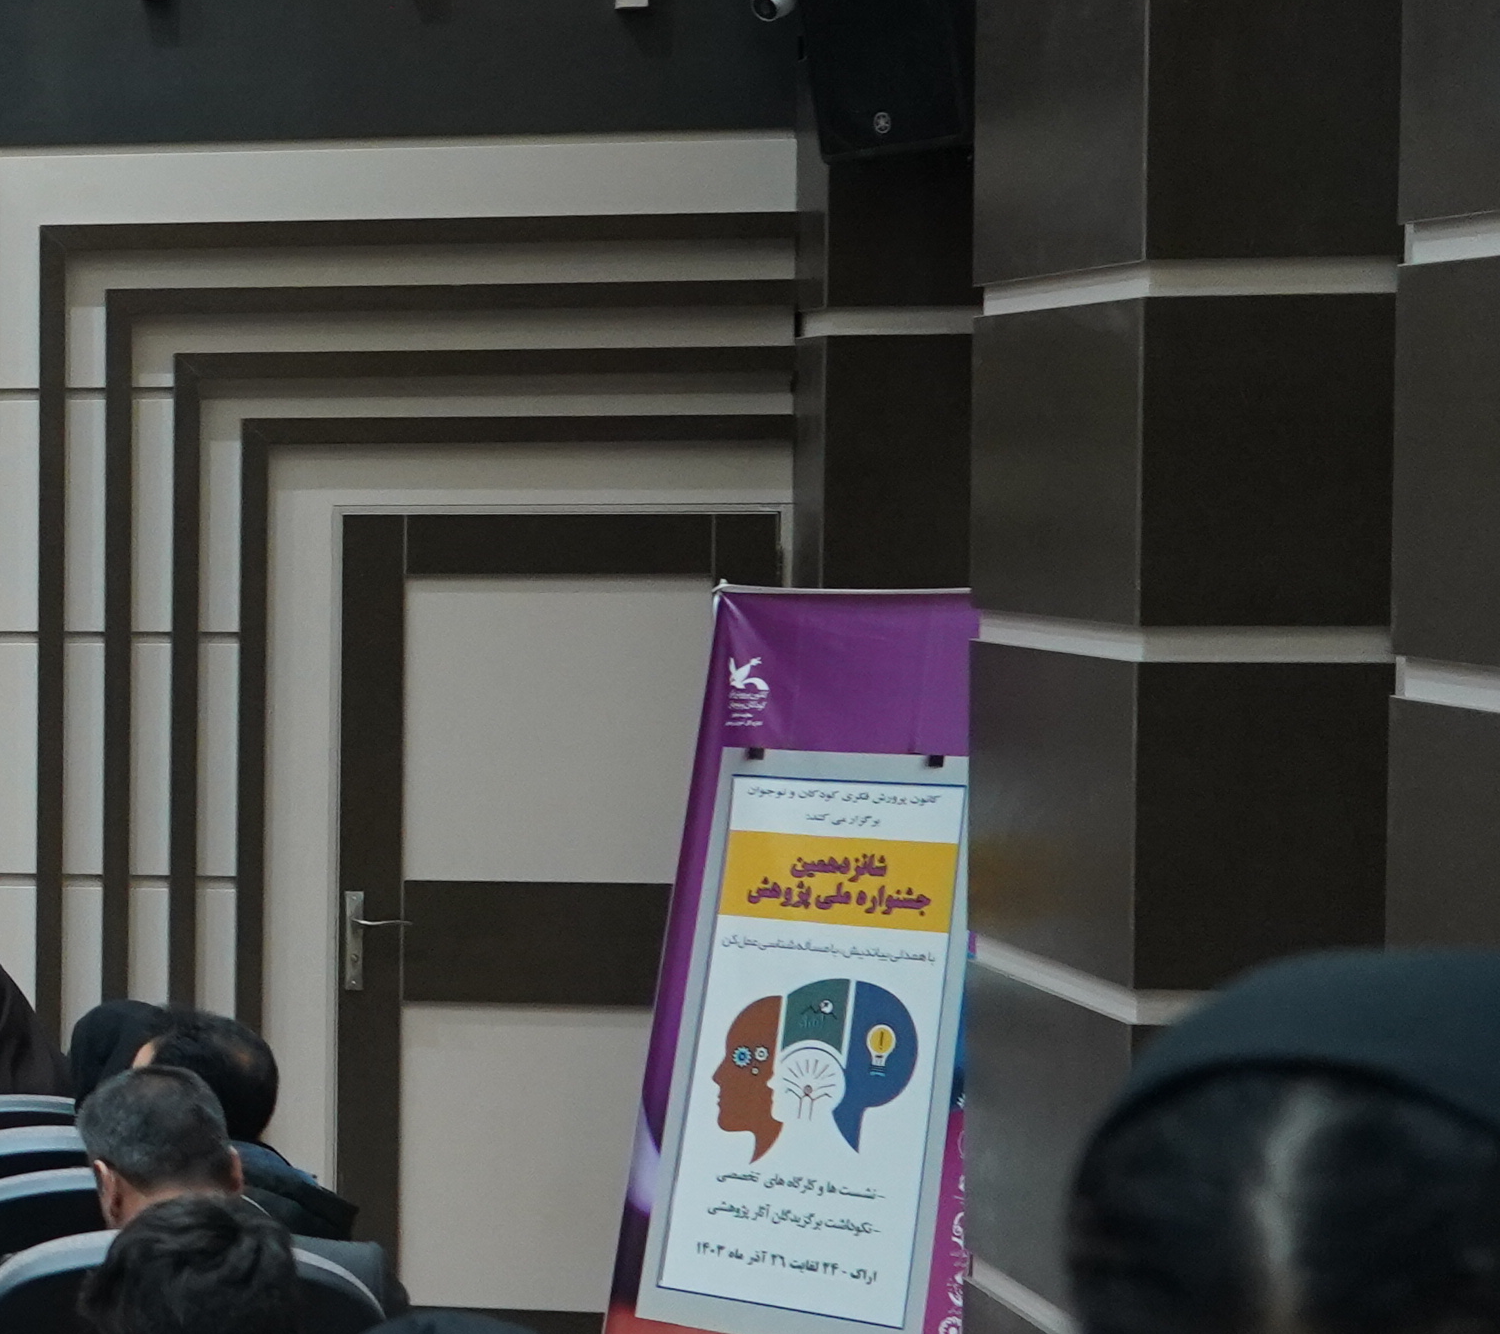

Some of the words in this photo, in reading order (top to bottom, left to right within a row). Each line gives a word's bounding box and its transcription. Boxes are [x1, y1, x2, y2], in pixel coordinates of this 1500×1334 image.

[790, 853, 888, 882] شانزدهمین
[747, 876, 812, 910] پژوهش
[815, 882, 851, 910] ملی
[856, 884, 931, 916] جشنواره
